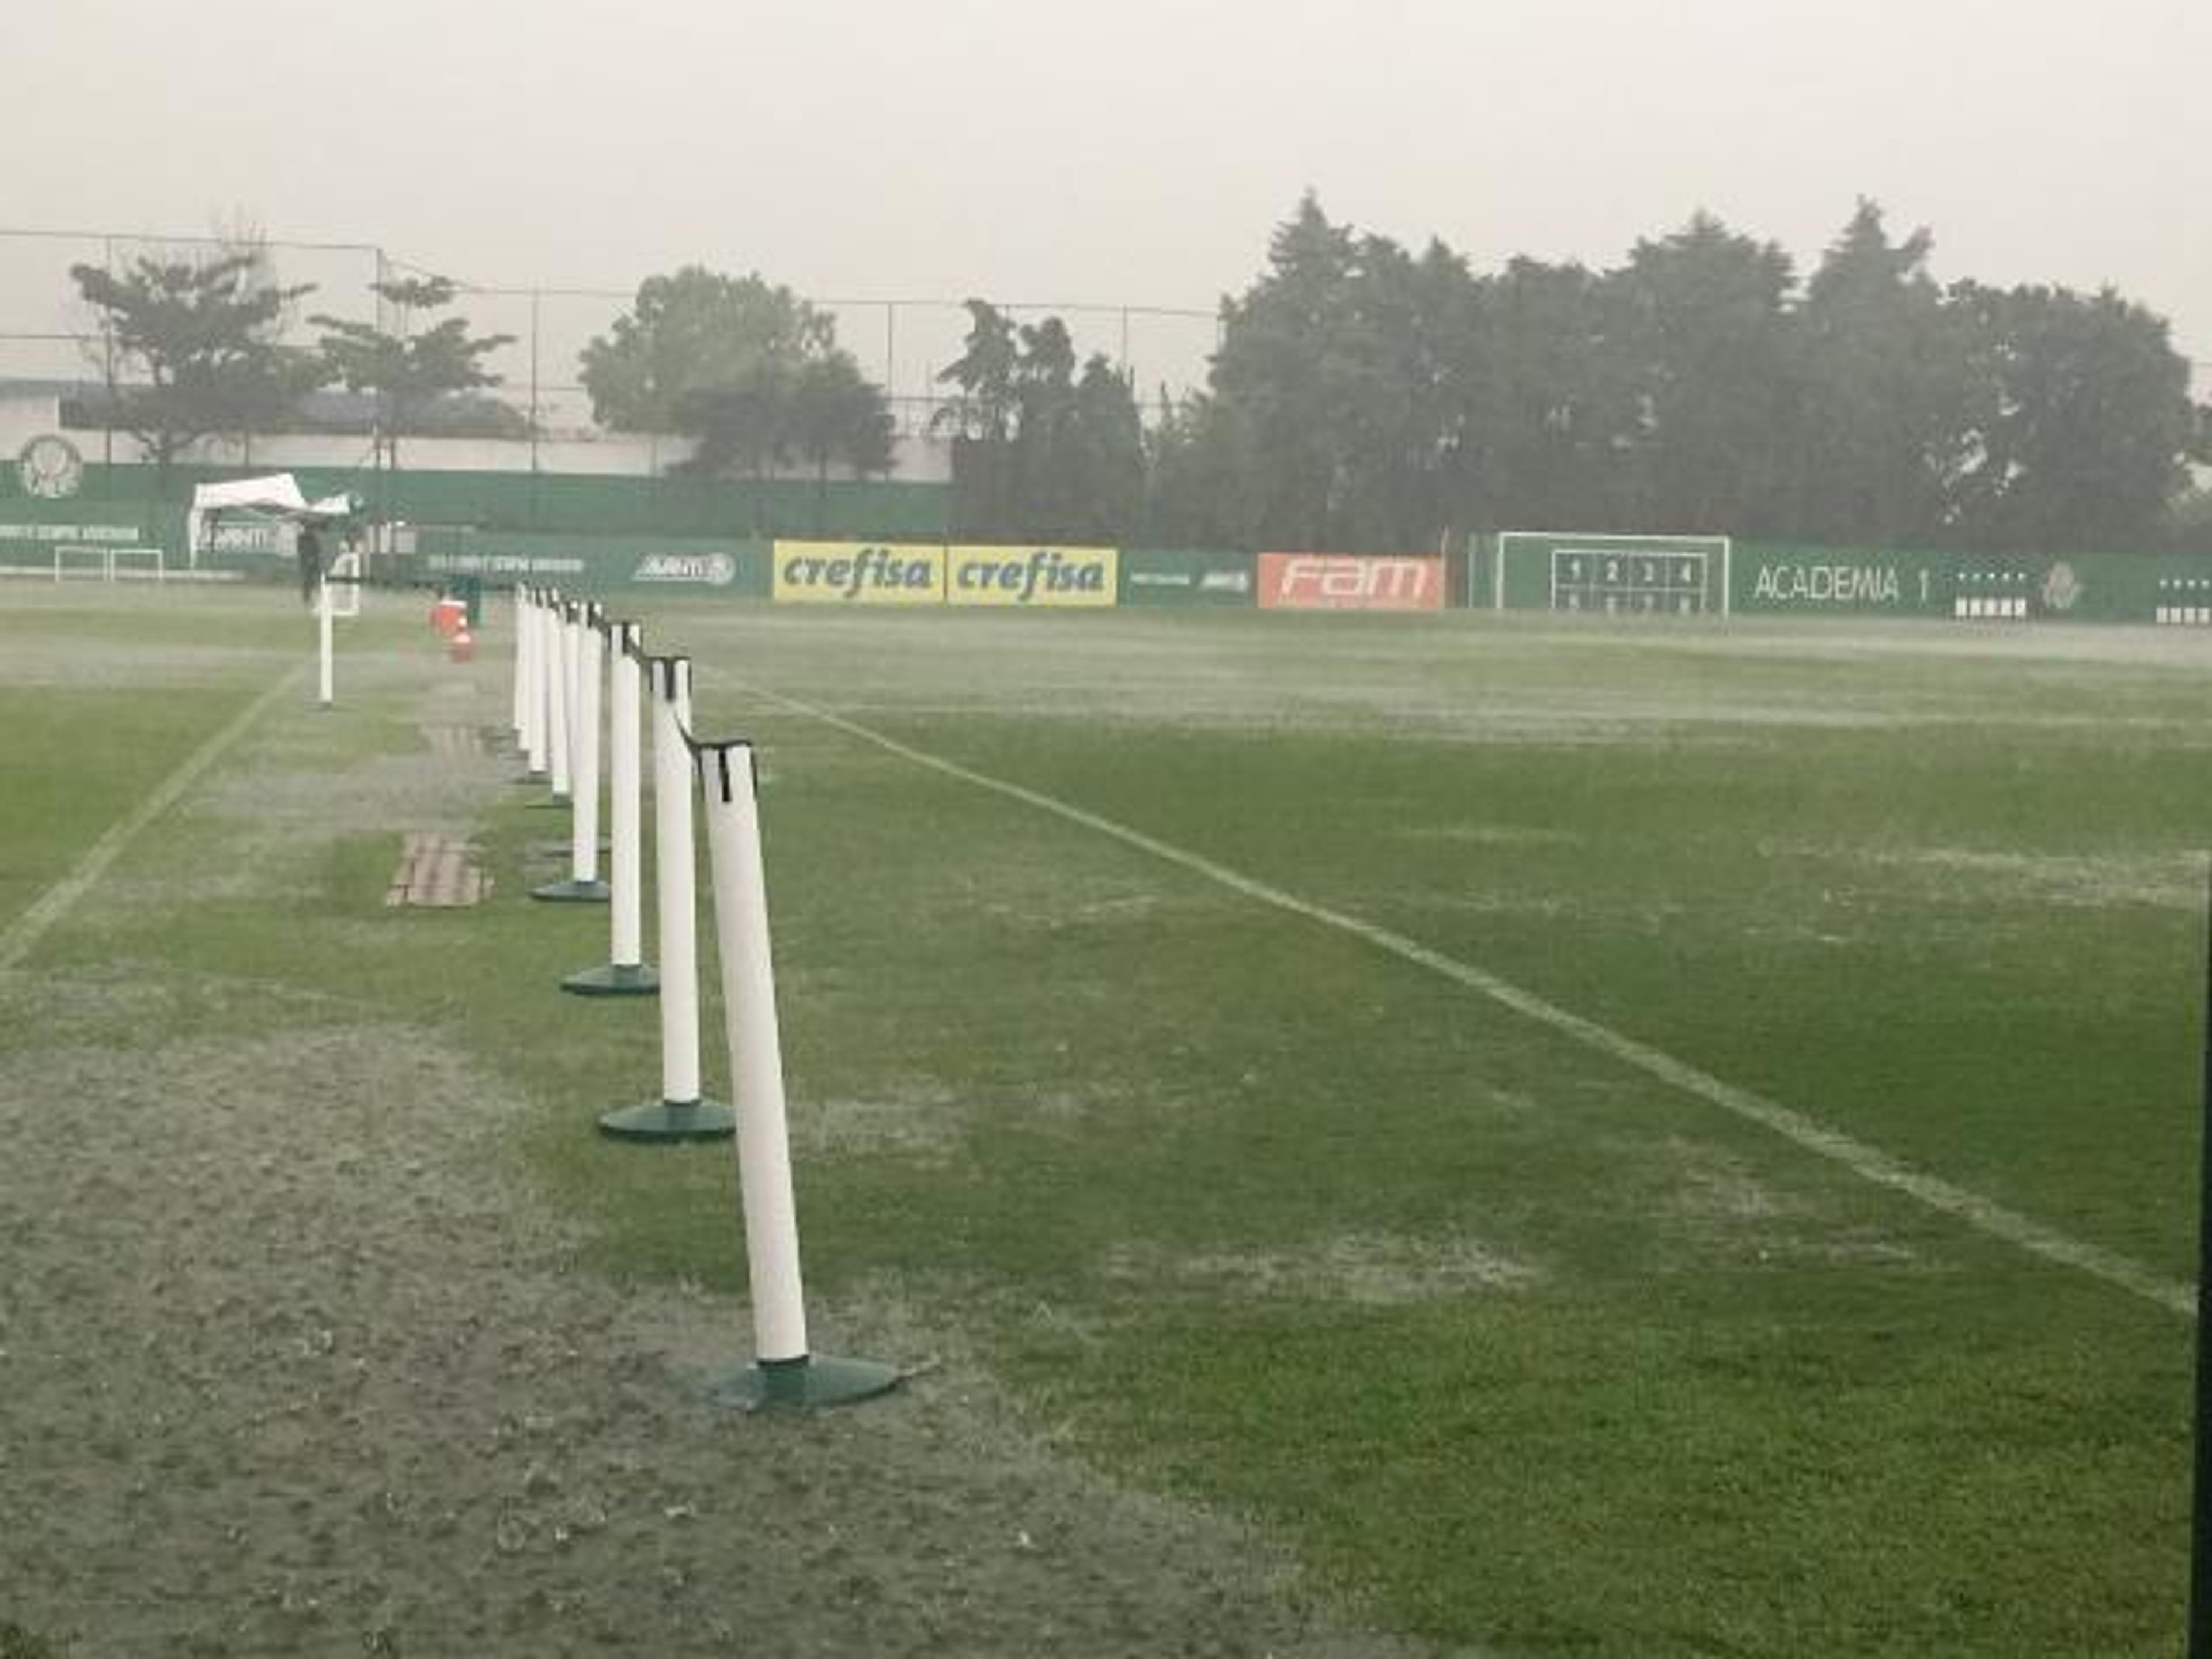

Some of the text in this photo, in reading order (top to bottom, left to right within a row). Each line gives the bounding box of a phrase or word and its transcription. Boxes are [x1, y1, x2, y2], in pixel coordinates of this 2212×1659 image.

[783, 549, 932, 599] crefisa
[957, 552, 1104, 601] crefisa
[1606, 560, 1618, 581] 2
[1755, 565, 1900, 601] ACADEMIA
